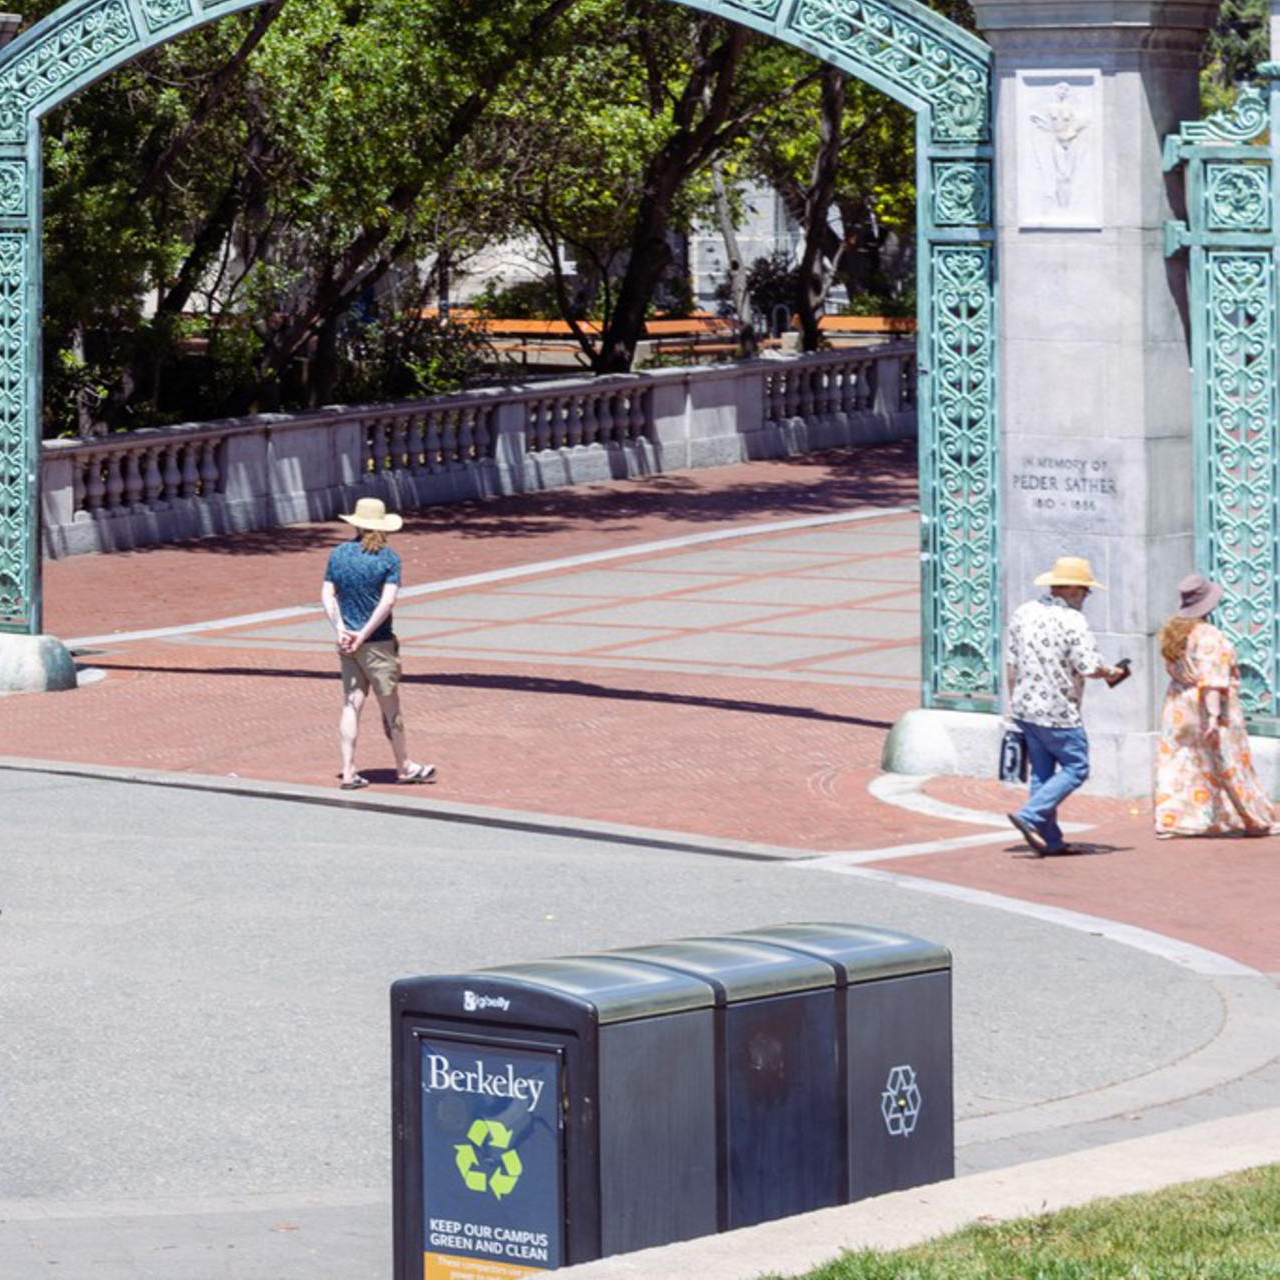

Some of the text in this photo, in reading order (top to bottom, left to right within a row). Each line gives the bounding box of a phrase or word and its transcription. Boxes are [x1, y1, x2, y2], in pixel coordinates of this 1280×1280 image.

[1022, 457, 1108, 472] IN MEMORY OF
[1012, 474, 1118, 494] PEDER SATHER
[427, 1054, 545, 1112] Berkeley
[429, 1218, 549, 1248] KEEP OUR CAMPUS
[429, 1233, 548, 1262] GREEN AND CLEAN
